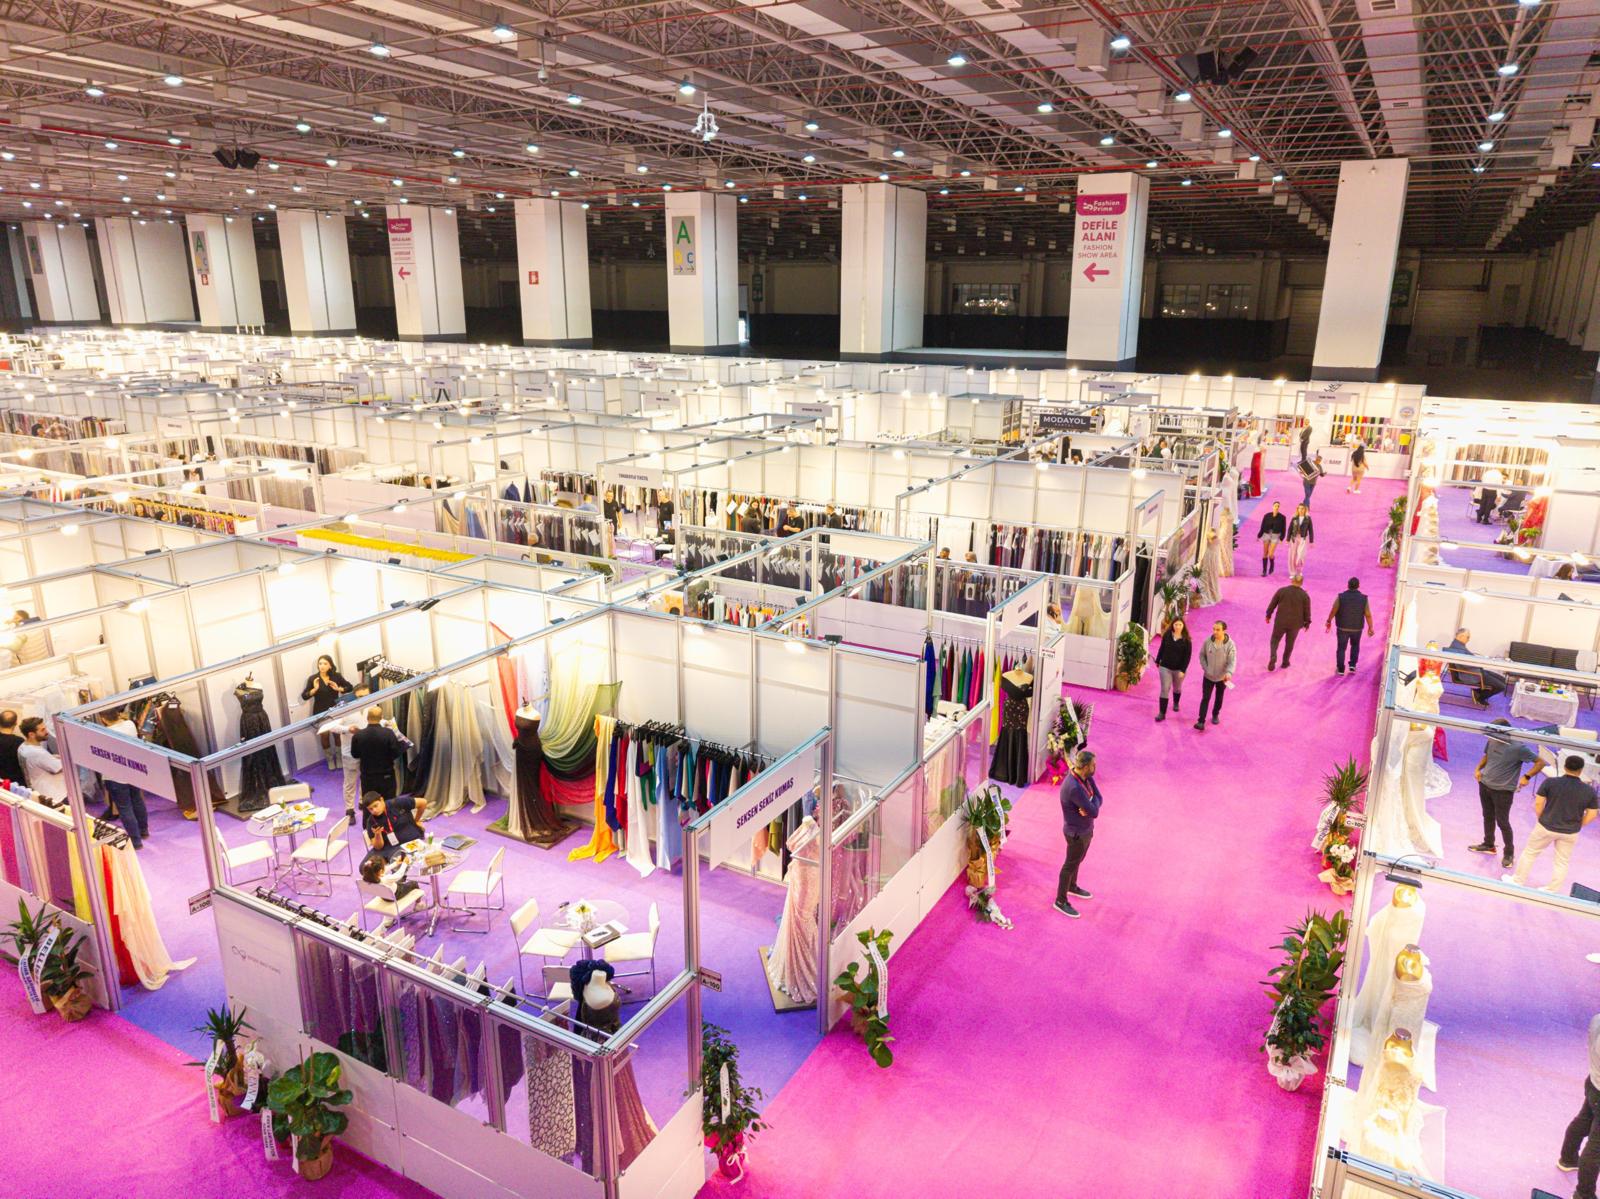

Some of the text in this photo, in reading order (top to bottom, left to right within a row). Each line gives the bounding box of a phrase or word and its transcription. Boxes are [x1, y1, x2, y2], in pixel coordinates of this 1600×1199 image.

[1082, 218, 1118, 230] DEFİLE
[676, 220, 691, 245] A
[1082, 232, 1116, 241] ALANI
[1043, 416, 1087, 425] MODAYOL
[90, 745, 111, 761] SEKSEN
[736, 777, 795, 829] SEKSEN SEKİZ KUMAŞ
